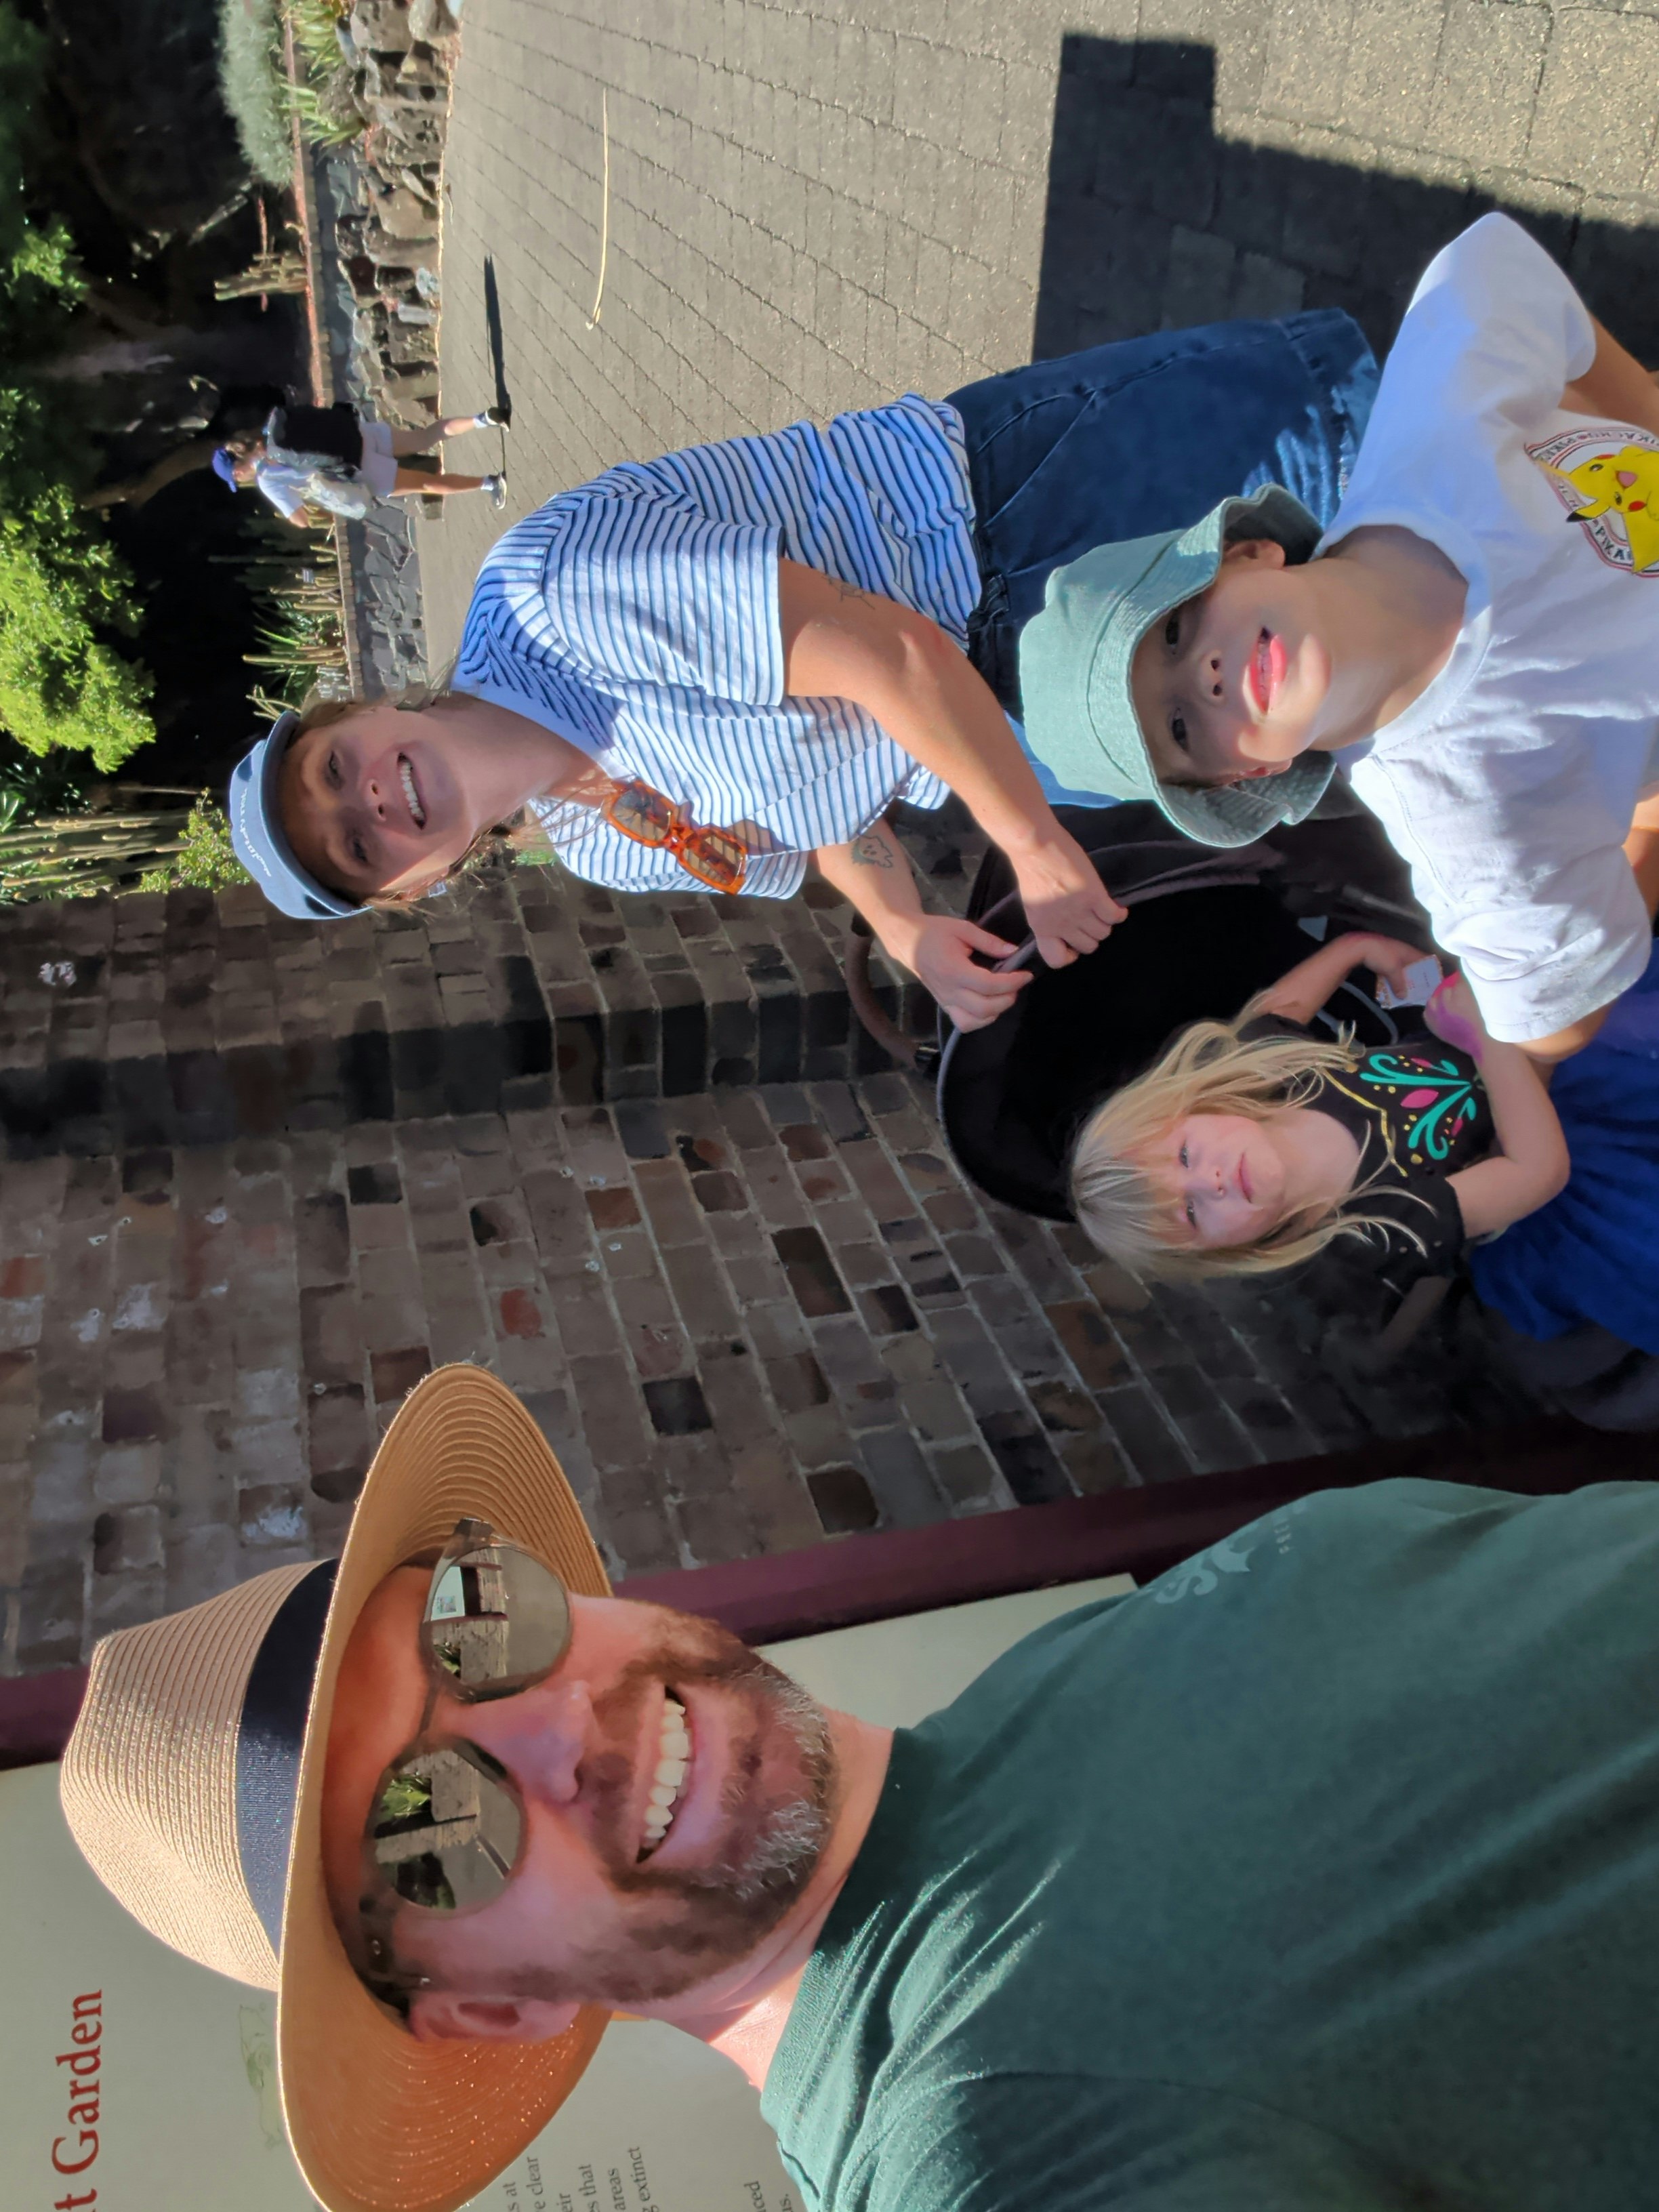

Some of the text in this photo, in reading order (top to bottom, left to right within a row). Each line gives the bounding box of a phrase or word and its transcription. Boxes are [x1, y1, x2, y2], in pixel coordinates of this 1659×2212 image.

[52, 1990, 102, 2212] t Garden
[502, 2182, 520, 2212] s at
[525, 2156, 546, 2212] e clear
[577, 2164, 596, 2196] that
[607, 2168, 626, 2211] areas
[628, 2146, 651, 2201] extinct
